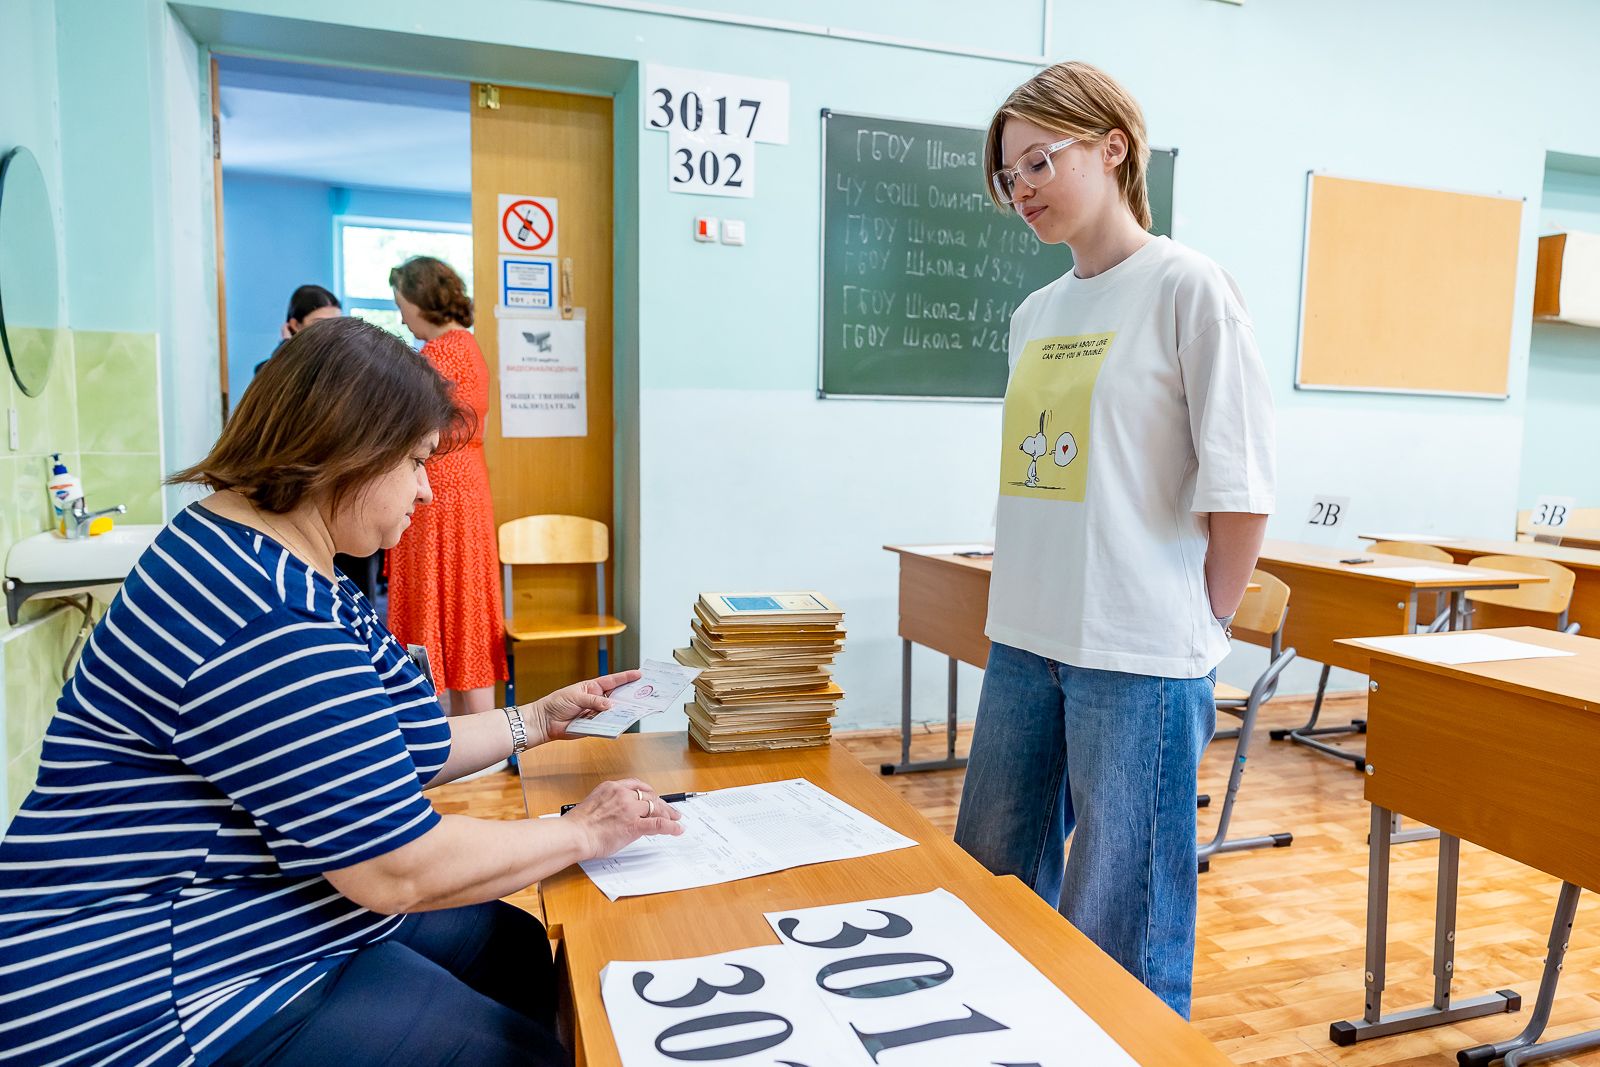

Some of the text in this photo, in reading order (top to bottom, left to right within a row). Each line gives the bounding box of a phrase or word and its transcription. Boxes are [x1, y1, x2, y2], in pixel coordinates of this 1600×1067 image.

[651, 88, 761, 138] 3017
[674, 148, 743, 187] 302
[857, 129, 977, 170] ГБОУ Школа
[837, 173, 867, 206] ЧУ
[875, 181, 920, 208] СОШ
[845, 213, 898, 246] ГБОУ
[908, 218, 967, 247] Школа
[905, 249, 969, 279] Школа
[842, 285, 896, 316] ГБОУ
[906, 292, 966, 322] Школа
[842, 323, 891, 350] ГБОУ
[903, 325, 963, 350] Школа
[1057, 342, 1078, 350] THINKING
[1079, 340, 1096, 348] ABOUT
[1055, 352, 1065, 360] GET
[778, 909, 1042, 1067] 301
[633, 963, 800, 1067] 30
